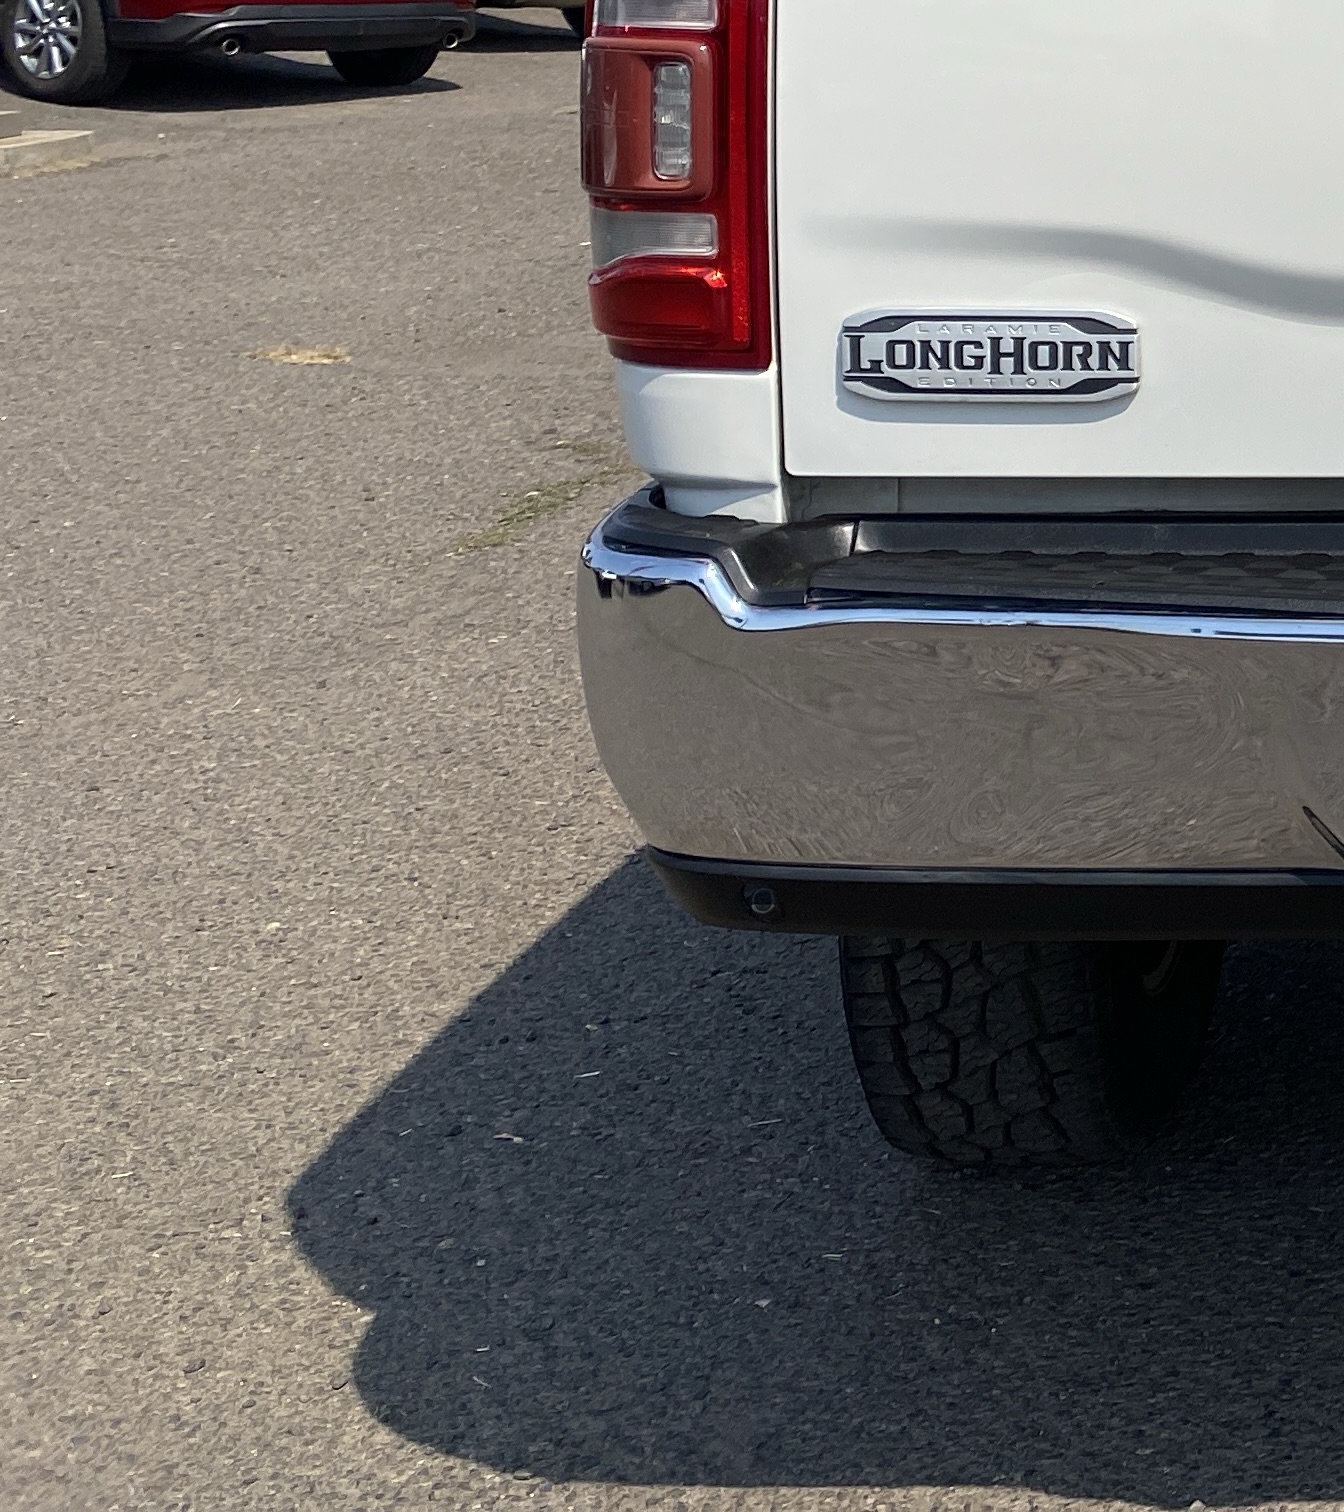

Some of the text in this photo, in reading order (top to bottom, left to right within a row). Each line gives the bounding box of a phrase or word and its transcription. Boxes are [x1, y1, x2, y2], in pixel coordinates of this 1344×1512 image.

[916, 322, 1062, 336] LARAMIE
[843, 335, 1135, 376] LONGHORN
[917, 376, 1062, 388] EDITION
